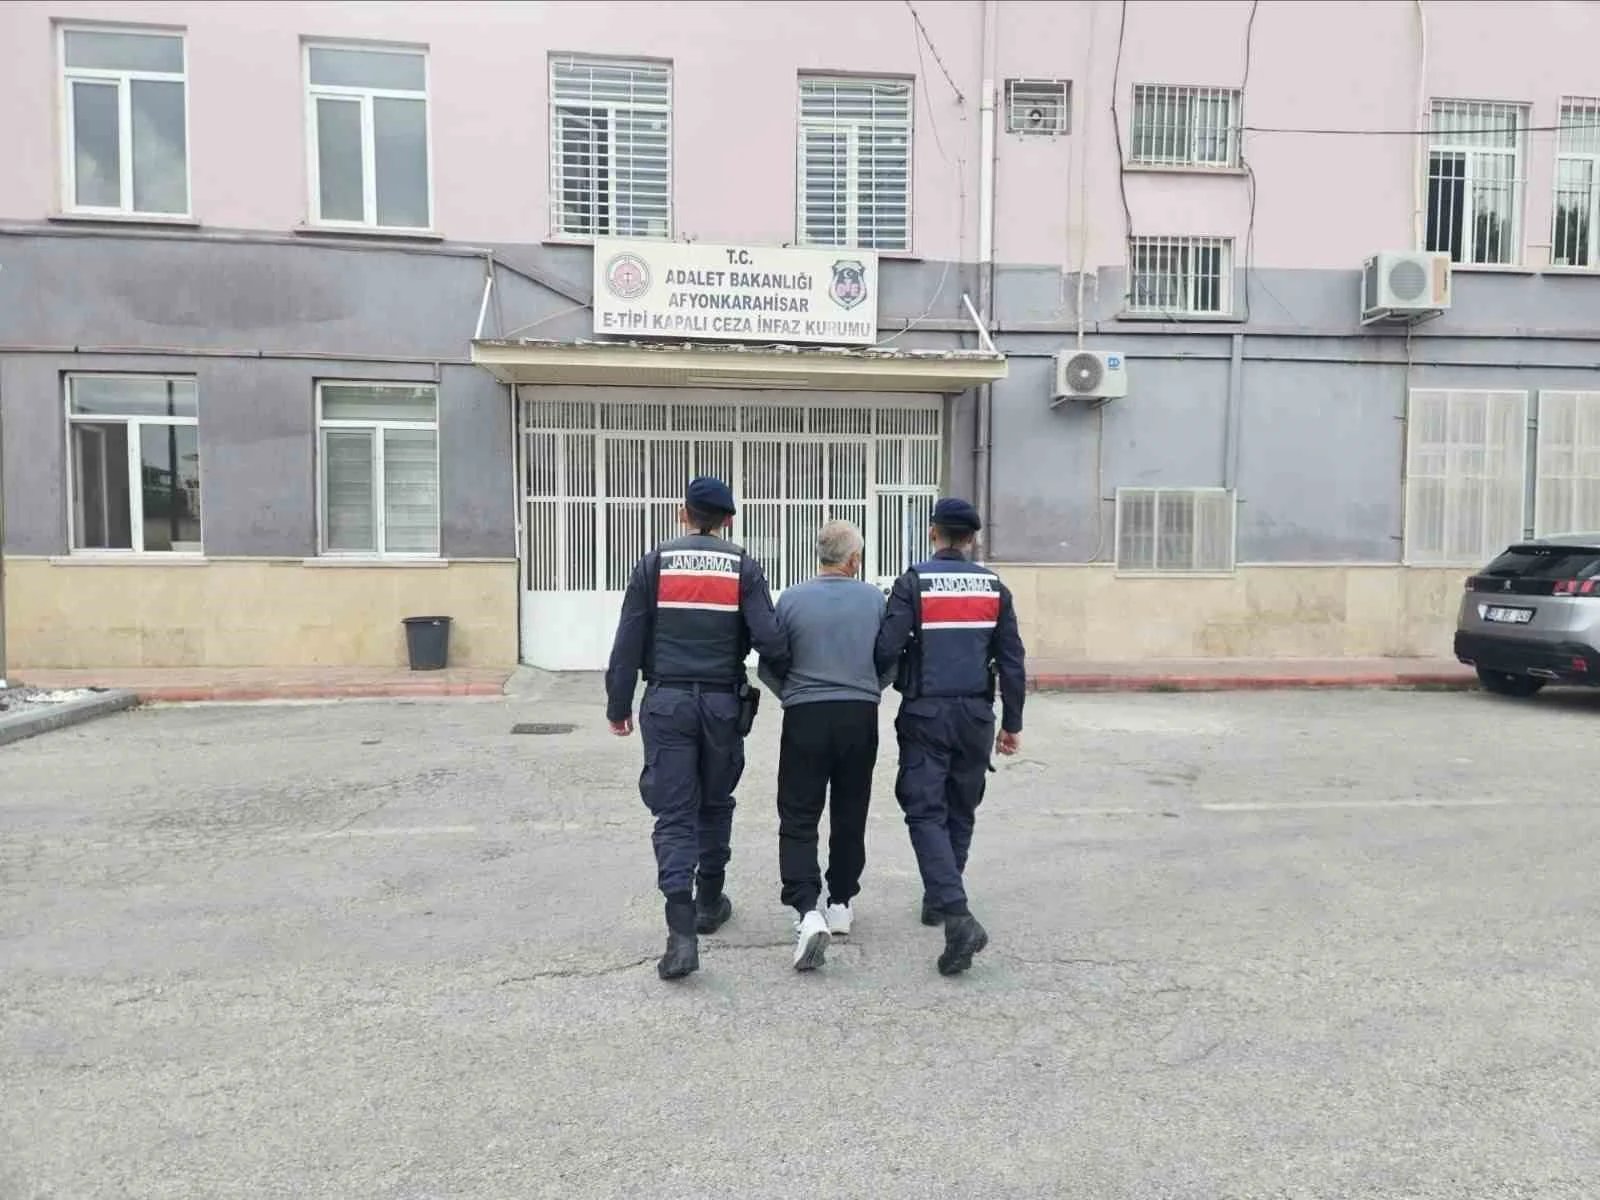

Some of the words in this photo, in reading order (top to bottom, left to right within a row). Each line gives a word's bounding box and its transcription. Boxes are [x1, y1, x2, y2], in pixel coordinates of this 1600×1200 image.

[726, 249, 753, 265] T.C.
[665, 269, 725, 287] ADALET
[730, 271, 813, 290] BAKANLIĞI
[668, 292, 809, 312] AFYONKARAHİSAR
[603, 310, 648, 330] E-TİPİ
[652, 313, 708, 331] KAPALI
[712, 317, 753, 333] CEZA
[757, 314, 801, 334] İNFAZ
[805, 319, 871, 337] KURUMU
[668, 554, 733, 573] JANDARMA
[928, 575, 992, 592] JANDARMA
